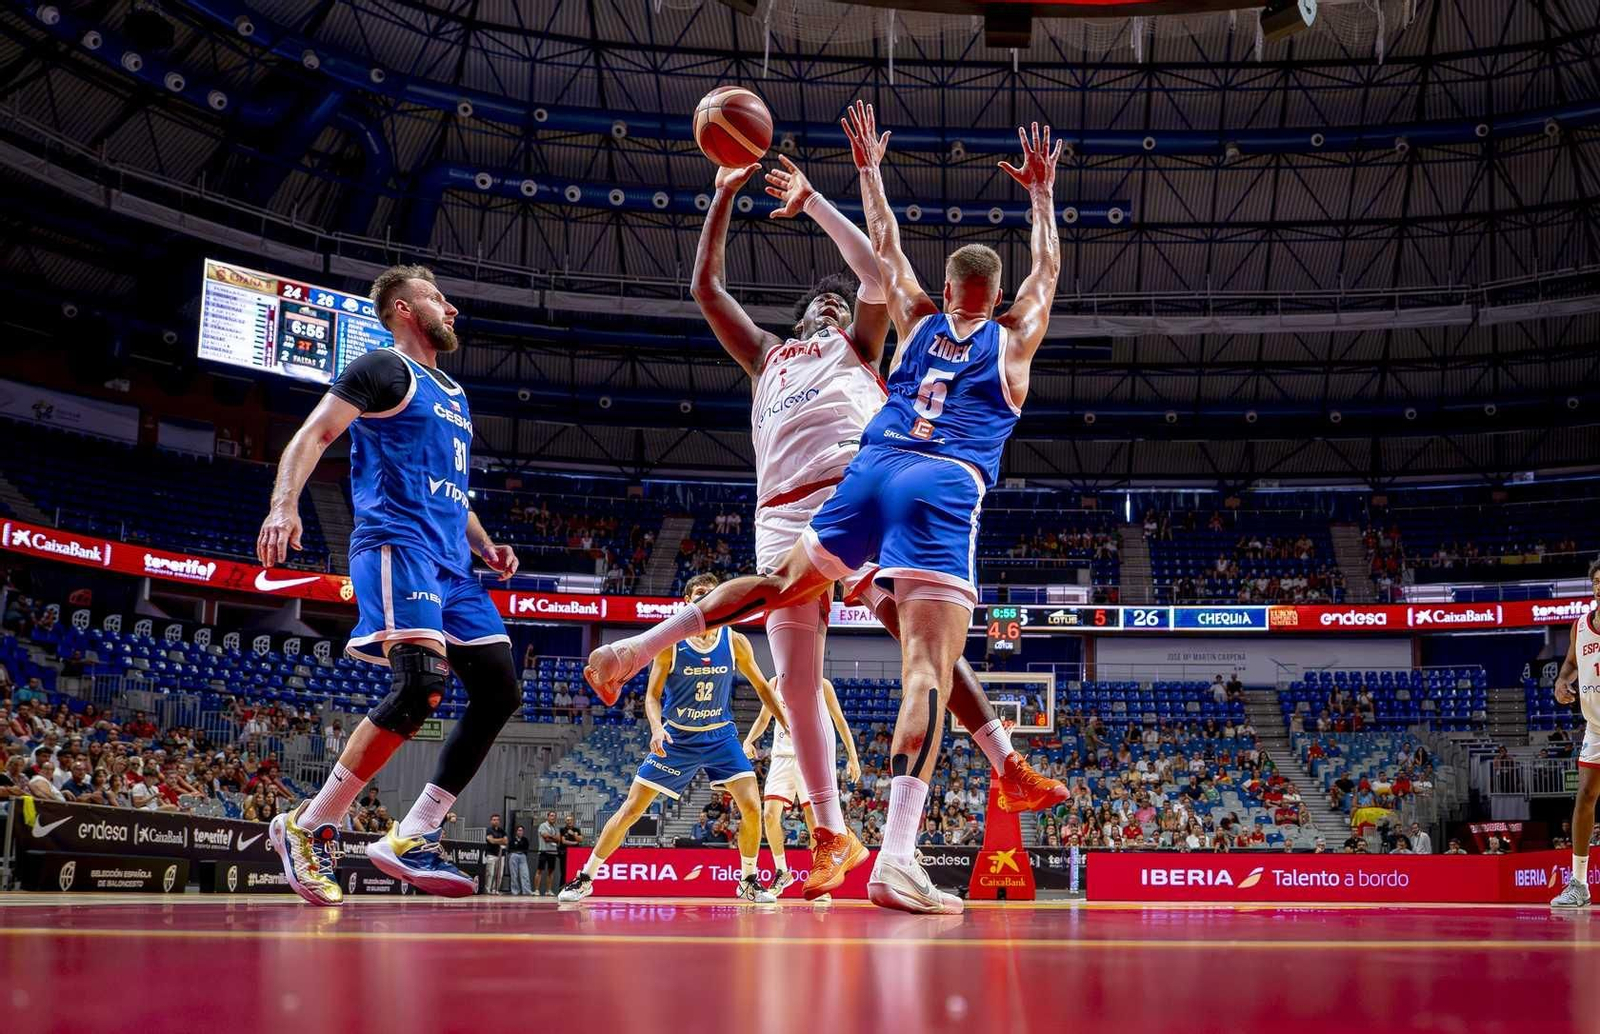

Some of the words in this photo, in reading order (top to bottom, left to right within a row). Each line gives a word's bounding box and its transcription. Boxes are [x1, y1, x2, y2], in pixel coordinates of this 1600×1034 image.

[283, 285, 302, 300] 24
[317, 293, 335, 308] 26
[291, 321, 325, 340] 6:55
[280, 350, 290, 361] 2
[318, 358, 326, 369] 1
[433, 401, 473, 432] ČESK
[454, 437, 467, 475] 31
[32, 533, 102, 562] CaixaBank
[144, 553, 217, 581] tenerife!
[536, 599, 599, 616] CaixaBank
[636, 601, 687, 616] tenerif
[992, 608, 1017, 619] 6:55
[1432, 609, 1495, 624] CaixaBank
[1093, 610, 1107, 627] 5
[1132, 609, 1159, 627] 26
[1320, 610, 1388, 626] endesa
[987, 621, 1020, 640] 4.6
[683, 665, 729, 677] ČESKO
[695, 681, 714, 702] 32
[687, 707, 723, 720] Tipsport
[78, 821, 128, 842] endesa
[149, 829, 184, 845] CaixaBank
[194, 828, 234, 850] tenerife!
[593, 863, 678, 881] BERIA
[1141, 868, 1234, 886] IBERIA
[1271, 869, 1340, 887] Talento
[1343, 873, 1354, 886] a
[1358, 869, 1409, 887] bordo
[1515, 869, 1547, 887] IBERIA
[979, 876, 1027, 887] CaixaBank
